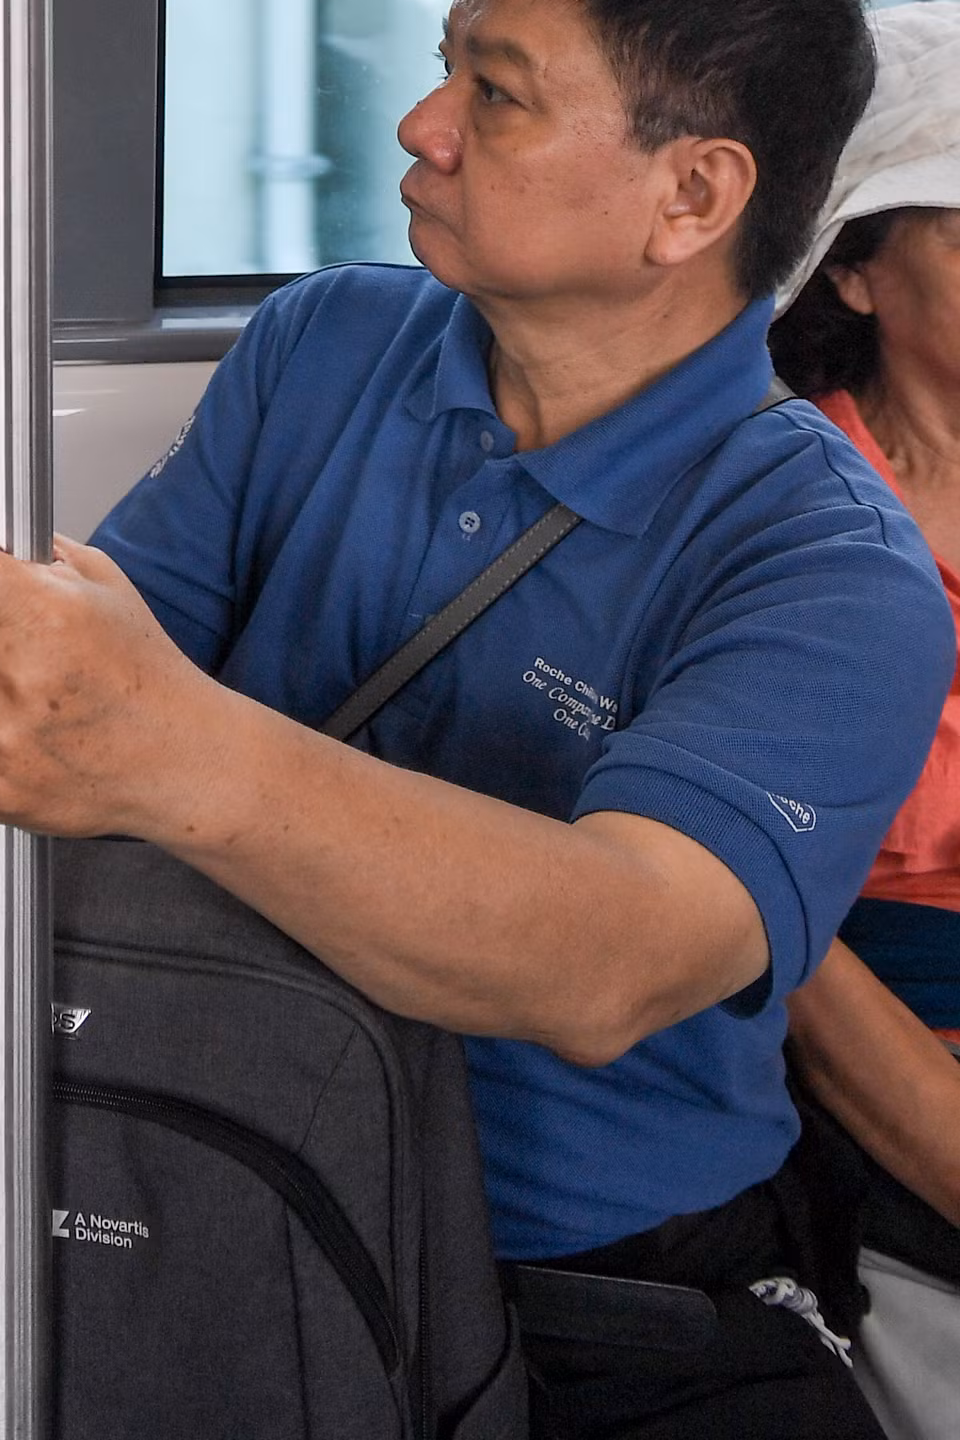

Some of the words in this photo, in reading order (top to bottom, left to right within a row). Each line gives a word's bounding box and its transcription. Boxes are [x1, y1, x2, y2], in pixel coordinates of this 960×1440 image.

[522, 670, 547, 690] One
[534, 657, 572, 686] Roche
[553, 708, 578, 730] One
[771, 793, 810, 824] oche
[74, 1213, 86, 1226] A
[90, 1213, 149, 1238] Novartis
[74, 1227, 133, 1249] Division
